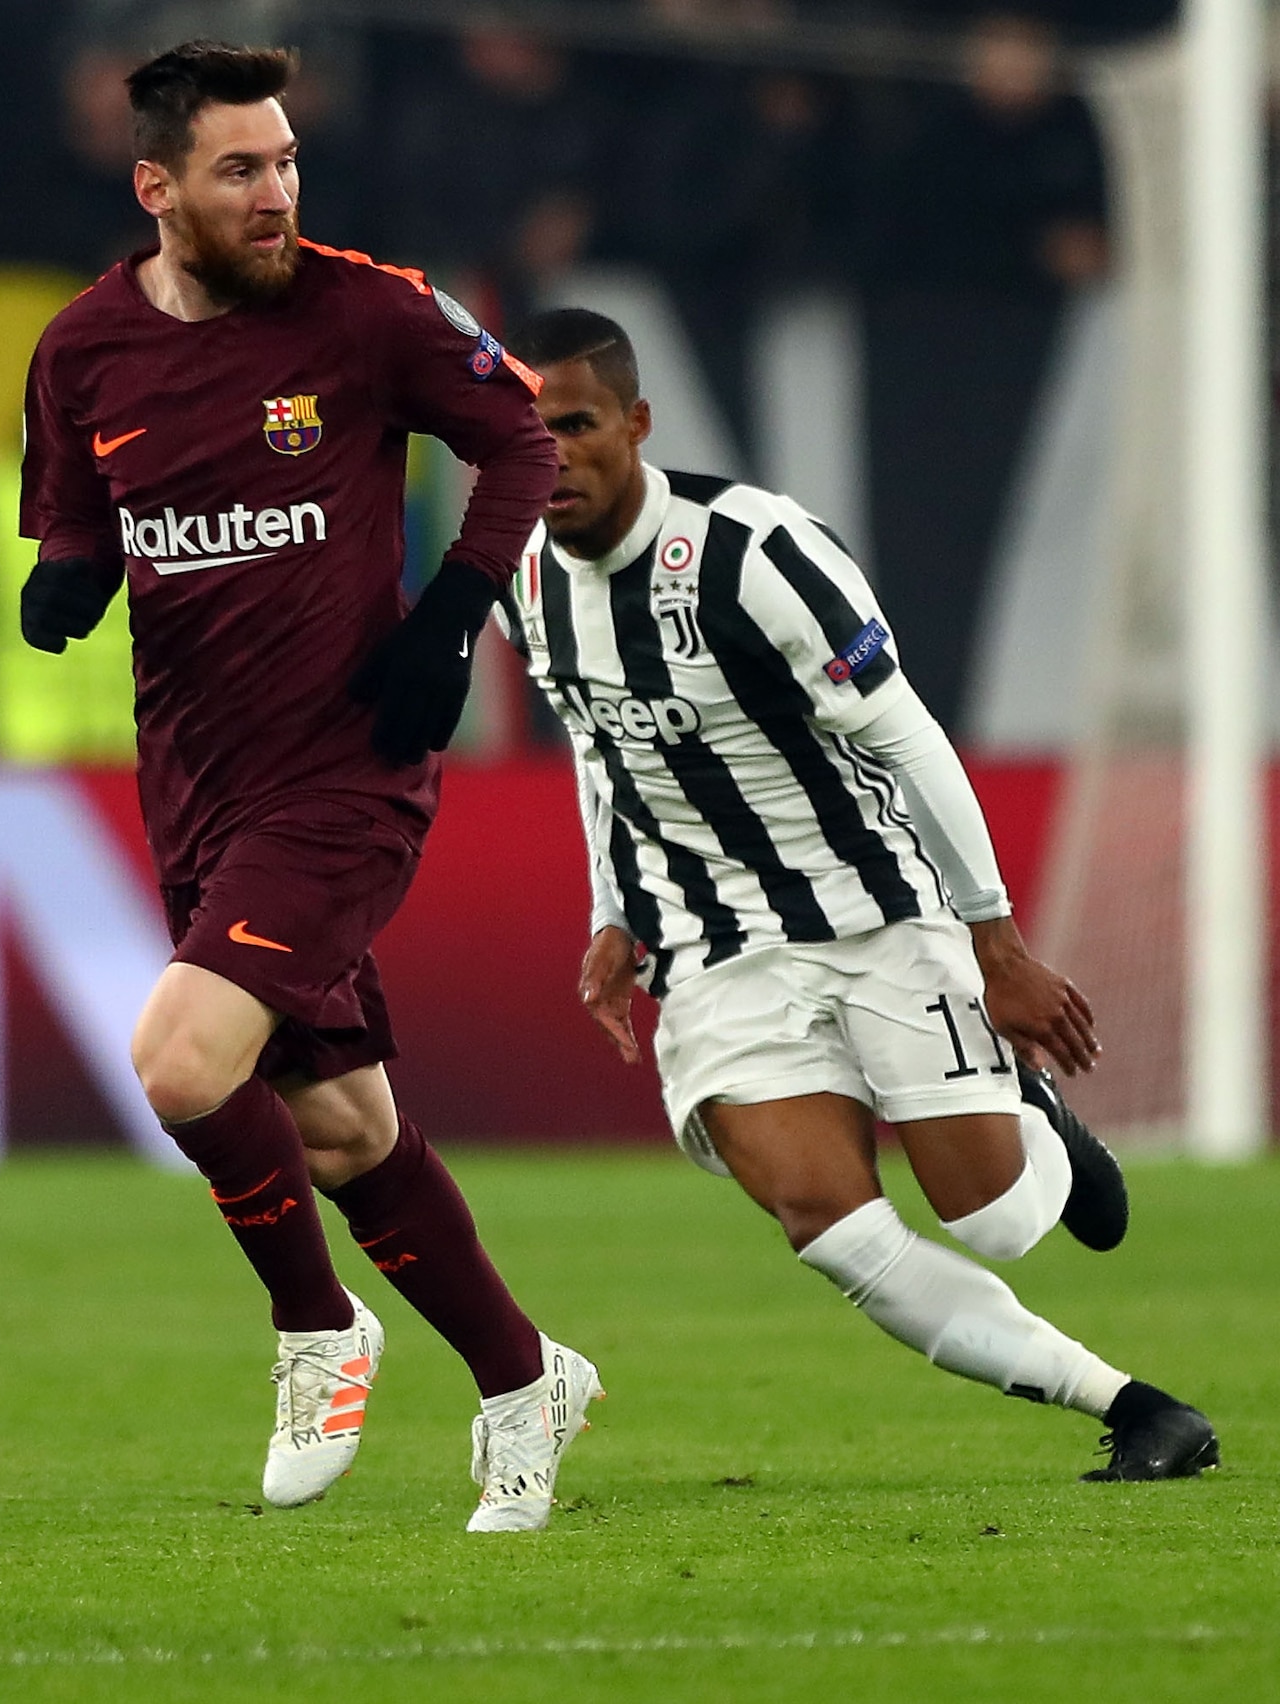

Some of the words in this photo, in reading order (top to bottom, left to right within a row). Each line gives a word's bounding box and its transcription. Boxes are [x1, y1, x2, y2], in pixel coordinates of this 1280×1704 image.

[118, 502, 327, 558] Rakuten
[847, 624, 885, 667] RESPECT
[565, 683, 701, 746] Jeep
[926, 993, 1012, 1080] 11
